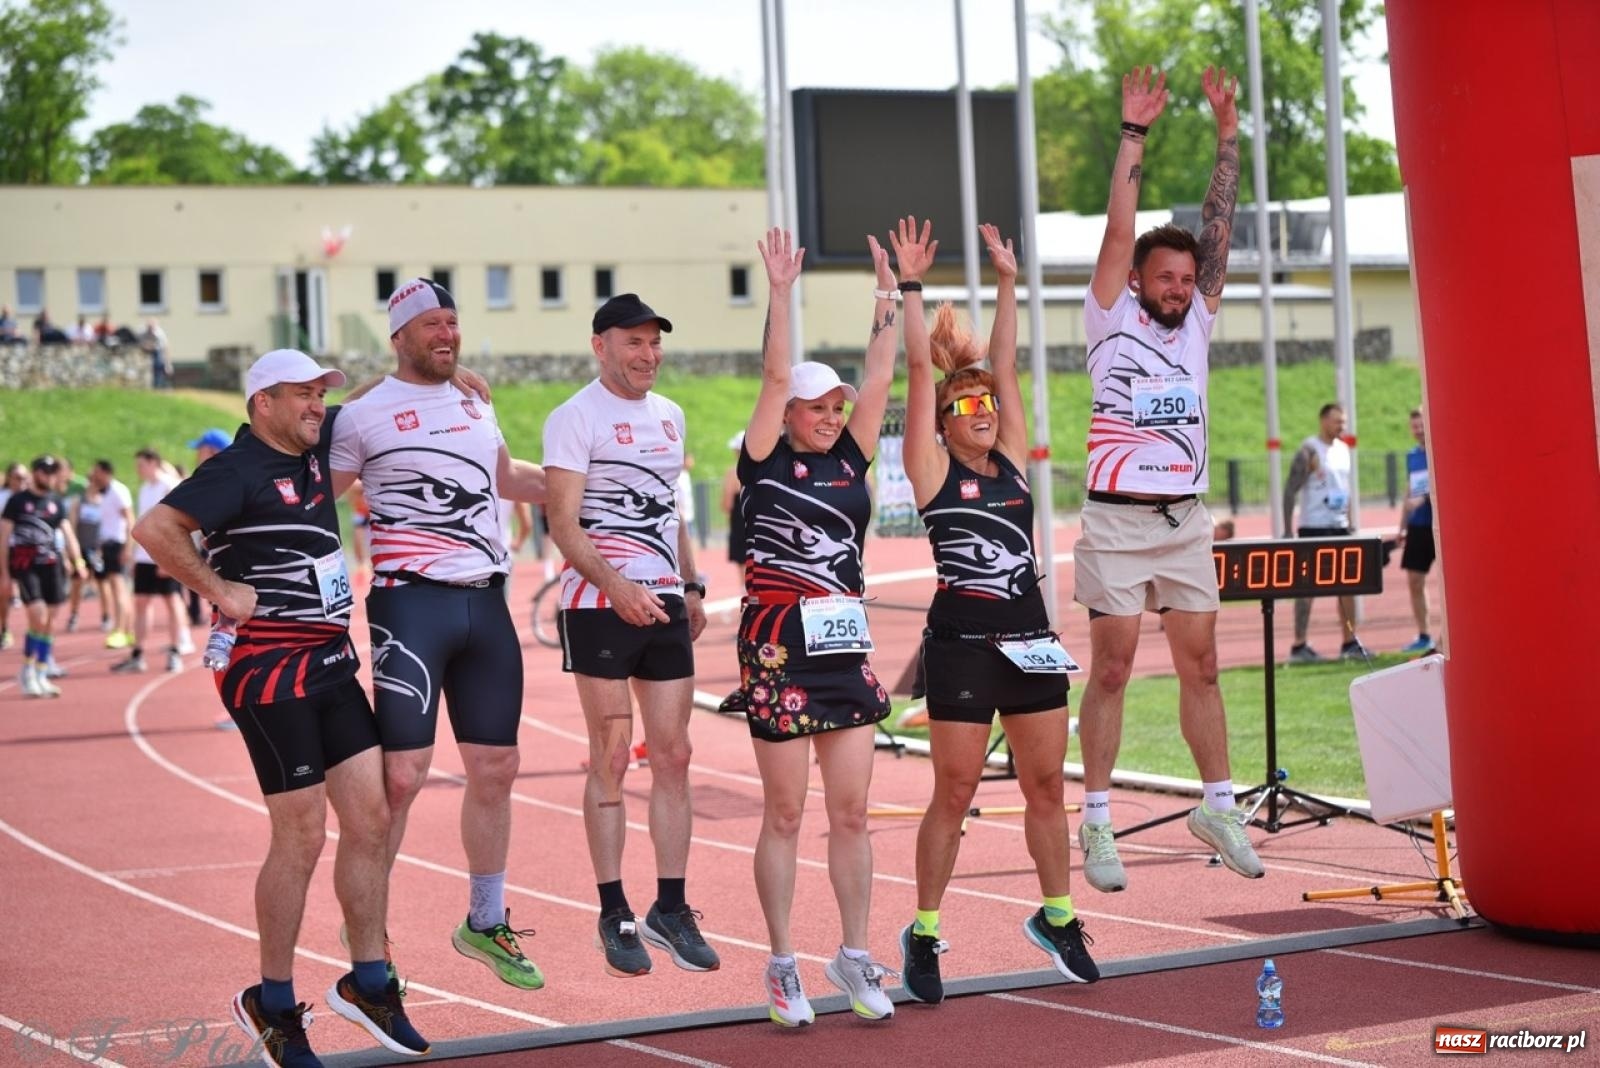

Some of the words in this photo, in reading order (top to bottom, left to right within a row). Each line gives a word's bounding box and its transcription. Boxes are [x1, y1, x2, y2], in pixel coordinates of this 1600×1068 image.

[1150, 397, 1186, 415] 250
[331, 575, 350, 599] 26
[823, 618, 858, 638] 256
[1024, 653, 1057, 665] 194
